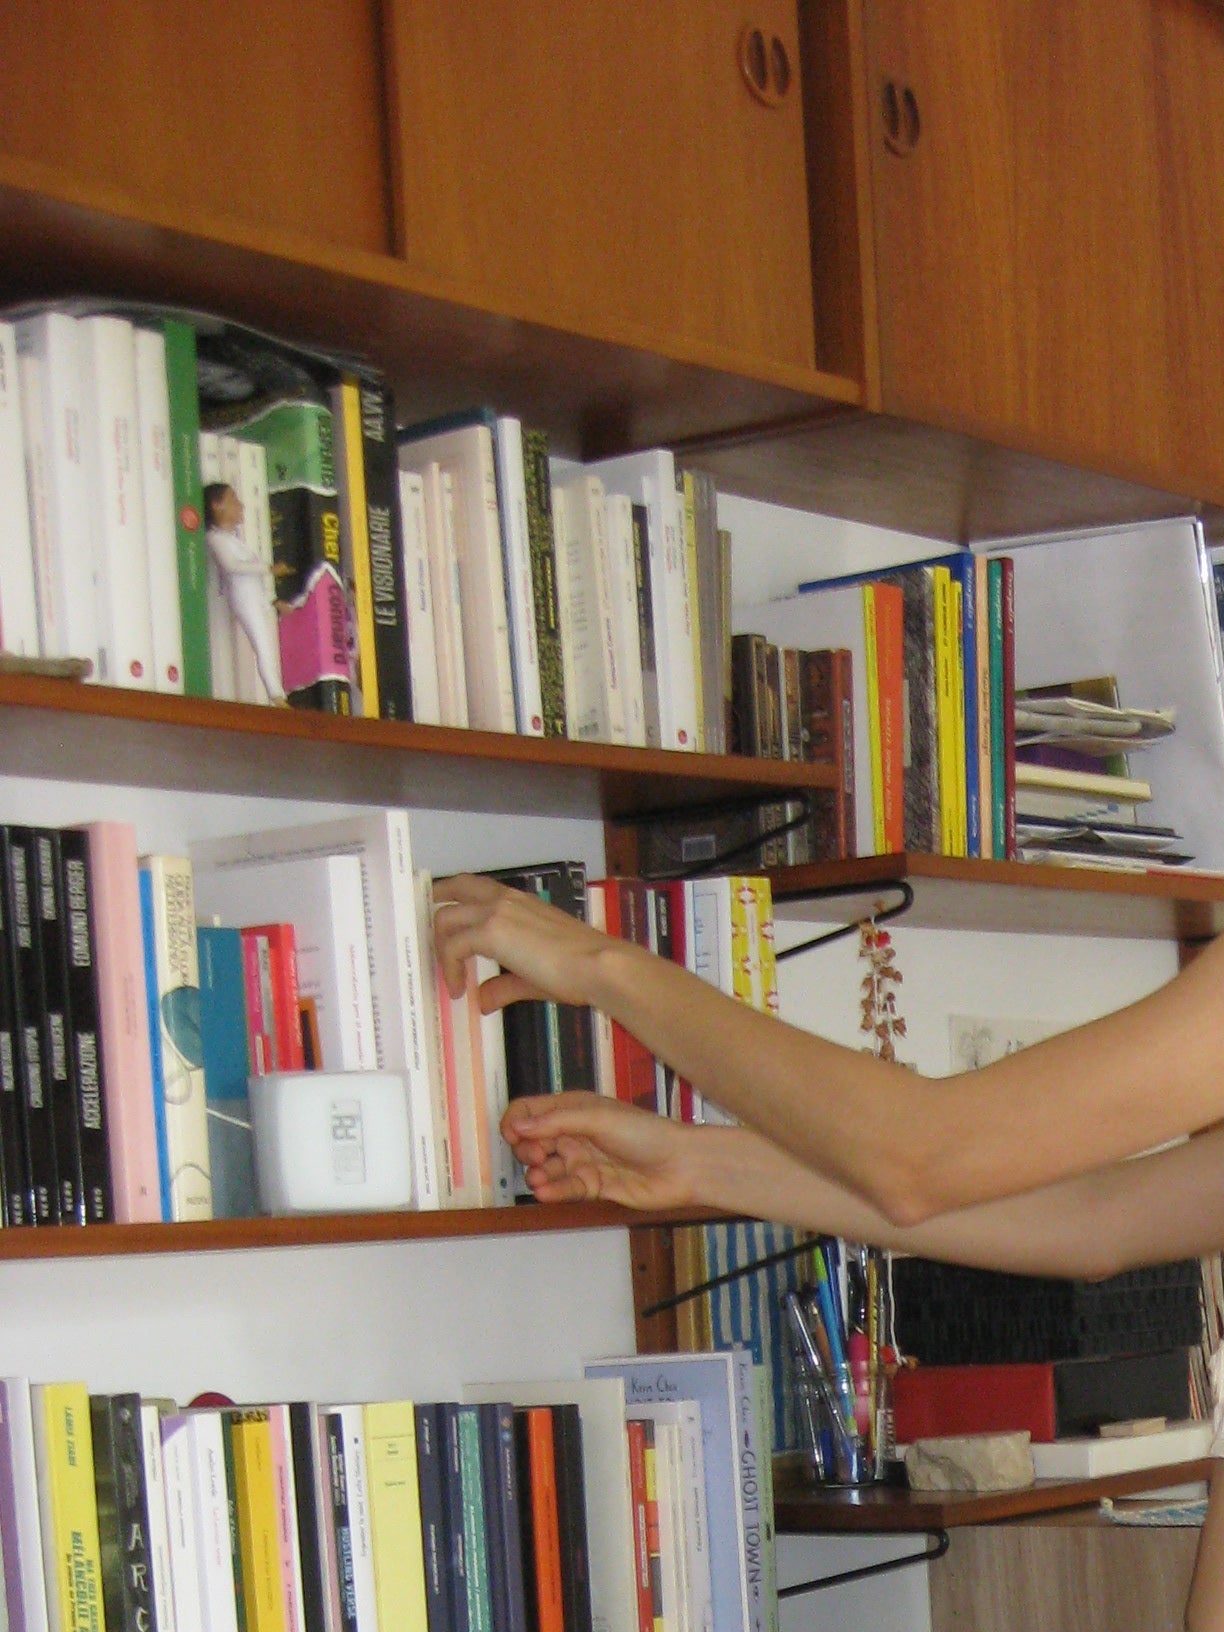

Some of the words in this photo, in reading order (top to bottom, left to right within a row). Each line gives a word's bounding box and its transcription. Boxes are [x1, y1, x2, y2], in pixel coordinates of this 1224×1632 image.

[321, 511, 340, 563] Cher
[370, 505, 397, 598] VISIONARIE
[376, 601, 398, 627] LE
[69, 911, 91, 967] EDMUND
[76, 1031, 101, 1129] ACCELERAZIONE
[742, 1450, 758, 1514] GHOST
[340, 1525, 353, 1582] HUSTLING
[748, 1523, 763, 1588] TOWN
[344, 1585, 357, 1620] VERSE
